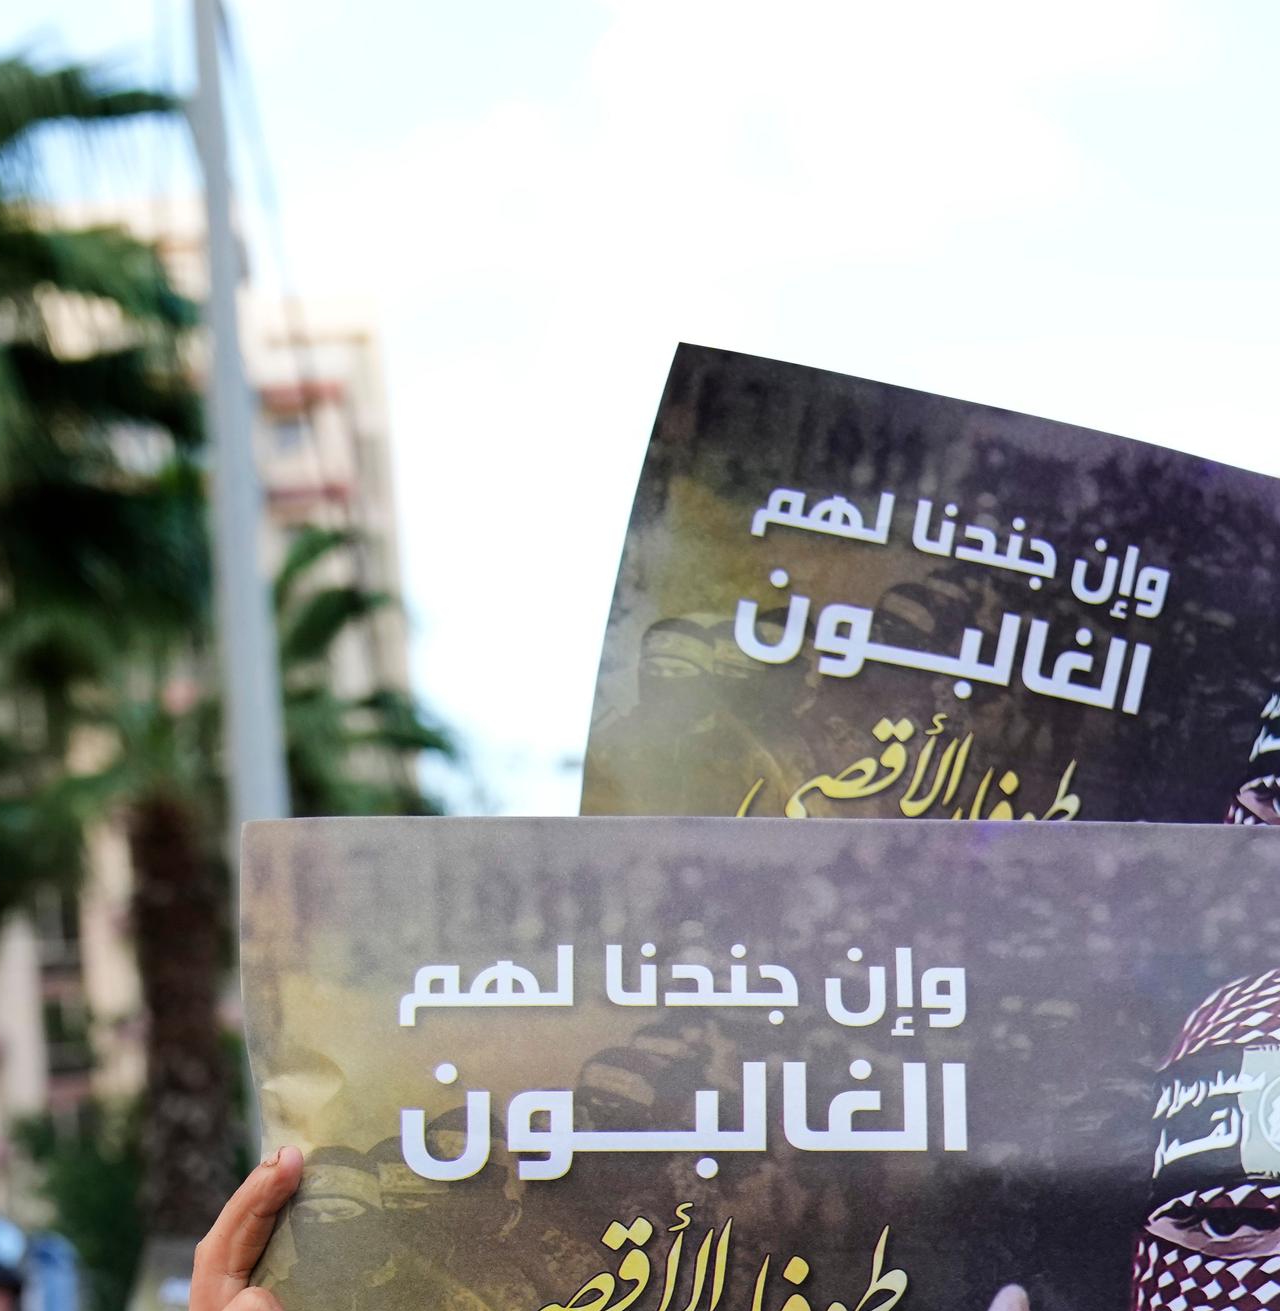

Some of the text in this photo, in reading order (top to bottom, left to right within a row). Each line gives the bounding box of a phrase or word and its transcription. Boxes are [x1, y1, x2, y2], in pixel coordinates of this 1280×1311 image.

[750, 487, 1170, 619] وإن جندنا لهم
[398, 942, 968, 1037] وإن جندنا لهم
